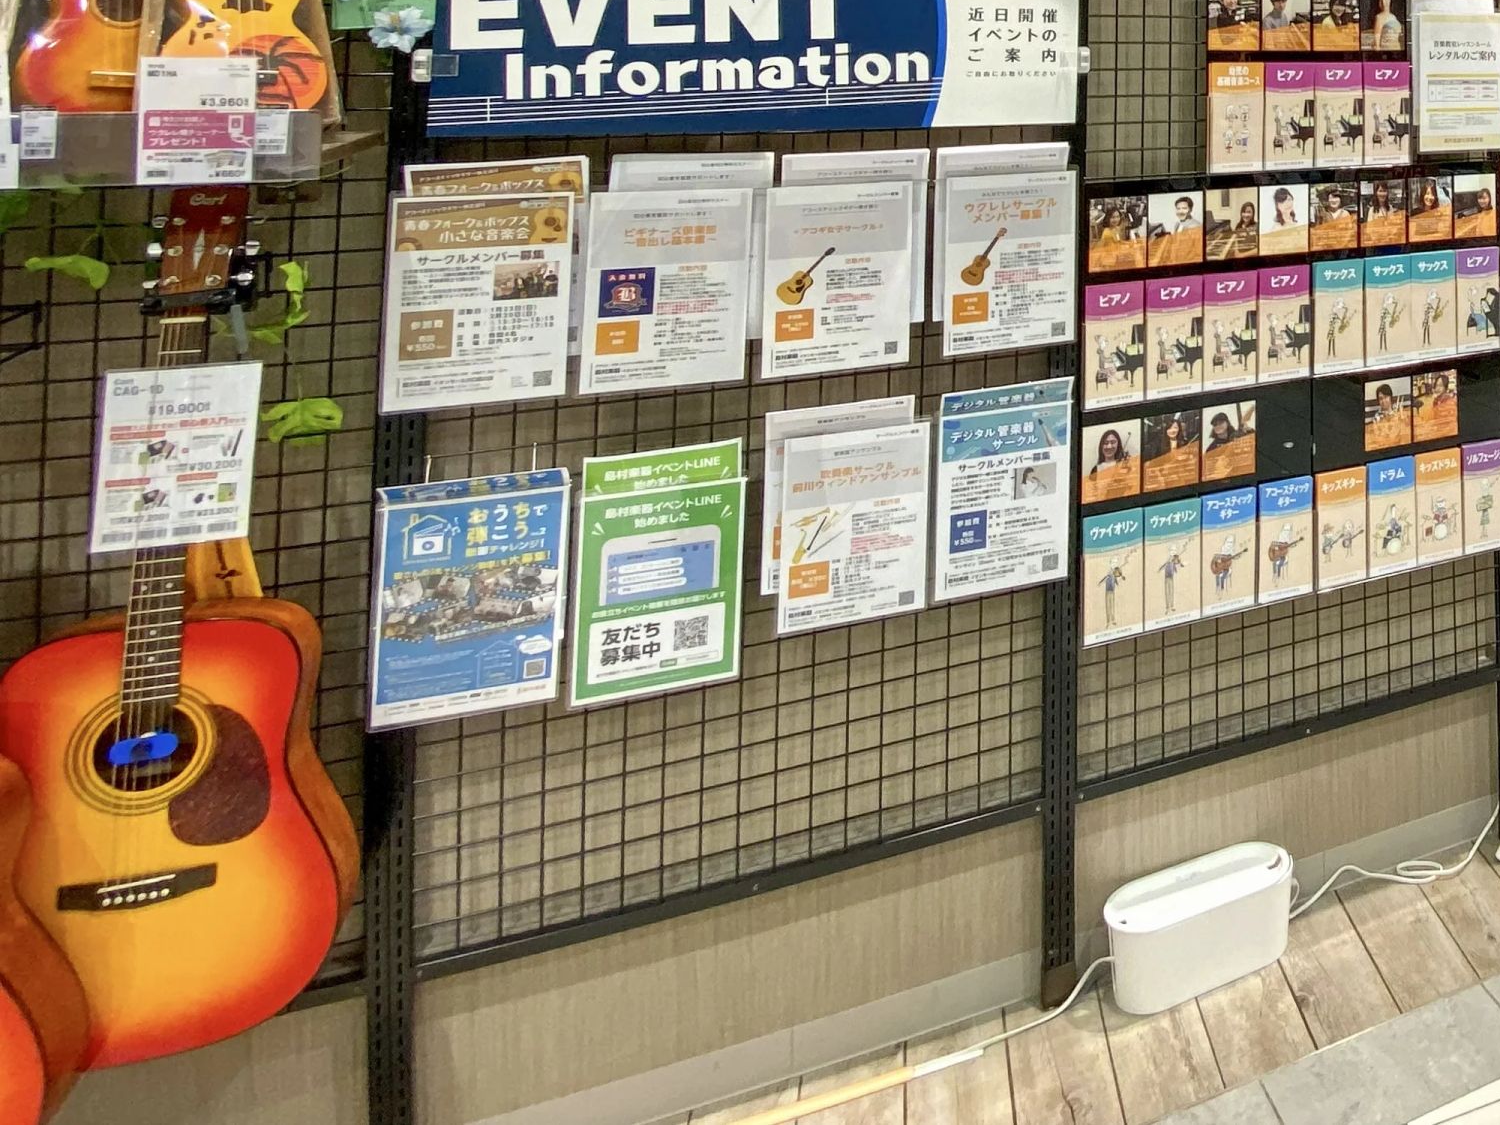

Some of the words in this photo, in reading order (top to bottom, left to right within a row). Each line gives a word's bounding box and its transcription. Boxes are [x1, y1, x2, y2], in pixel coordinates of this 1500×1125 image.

[968, 7, 1058, 23] 近日開催
[968, 27, 1057, 43] イベントの
[968, 47, 1057, 63] ご案内
[1429, 50, 1497, 62] レンタルのご案内
[505, 43, 930, 101] Information
[1277, 70, 1304, 82] ピアノ
[1326, 69, 1352, 81] ピアノ
[1375, 69, 1400, 80] ピアノ
[1417, 259, 1449, 273] サックス
[1466, 254, 1491, 268] ピアノ
[1323, 267, 1357, 281] サックス
[1372, 262, 1405, 278] サックス
[1216, 279, 1246, 295] ピアノ
[1270, 273, 1299, 289] ピアノ
[1099, 291, 1132, 308] ピアノ
[1160, 285, 1191, 301] ピアノ
[992, 435, 1038, 451] サークル
[1418, 458, 1458, 476] キッズドラム
[1379, 467, 1406, 484] ドラム
[1320, 476, 1364, 494] キッズギター
[1206, 493, 1253, 511] アコースティック
[1276, 496, 1297, 508] ギター
[634, 512, 690, 529] 始めました
[1150, 508, 1197, 529] ヴァイオリン
[1219, 507, 1240, 520] ギター
[1089, 519, 1139, 541] ヴァイオリン
[601, 622, 661, 646] 友だち
[600, 641, 661, 667] 募集中
